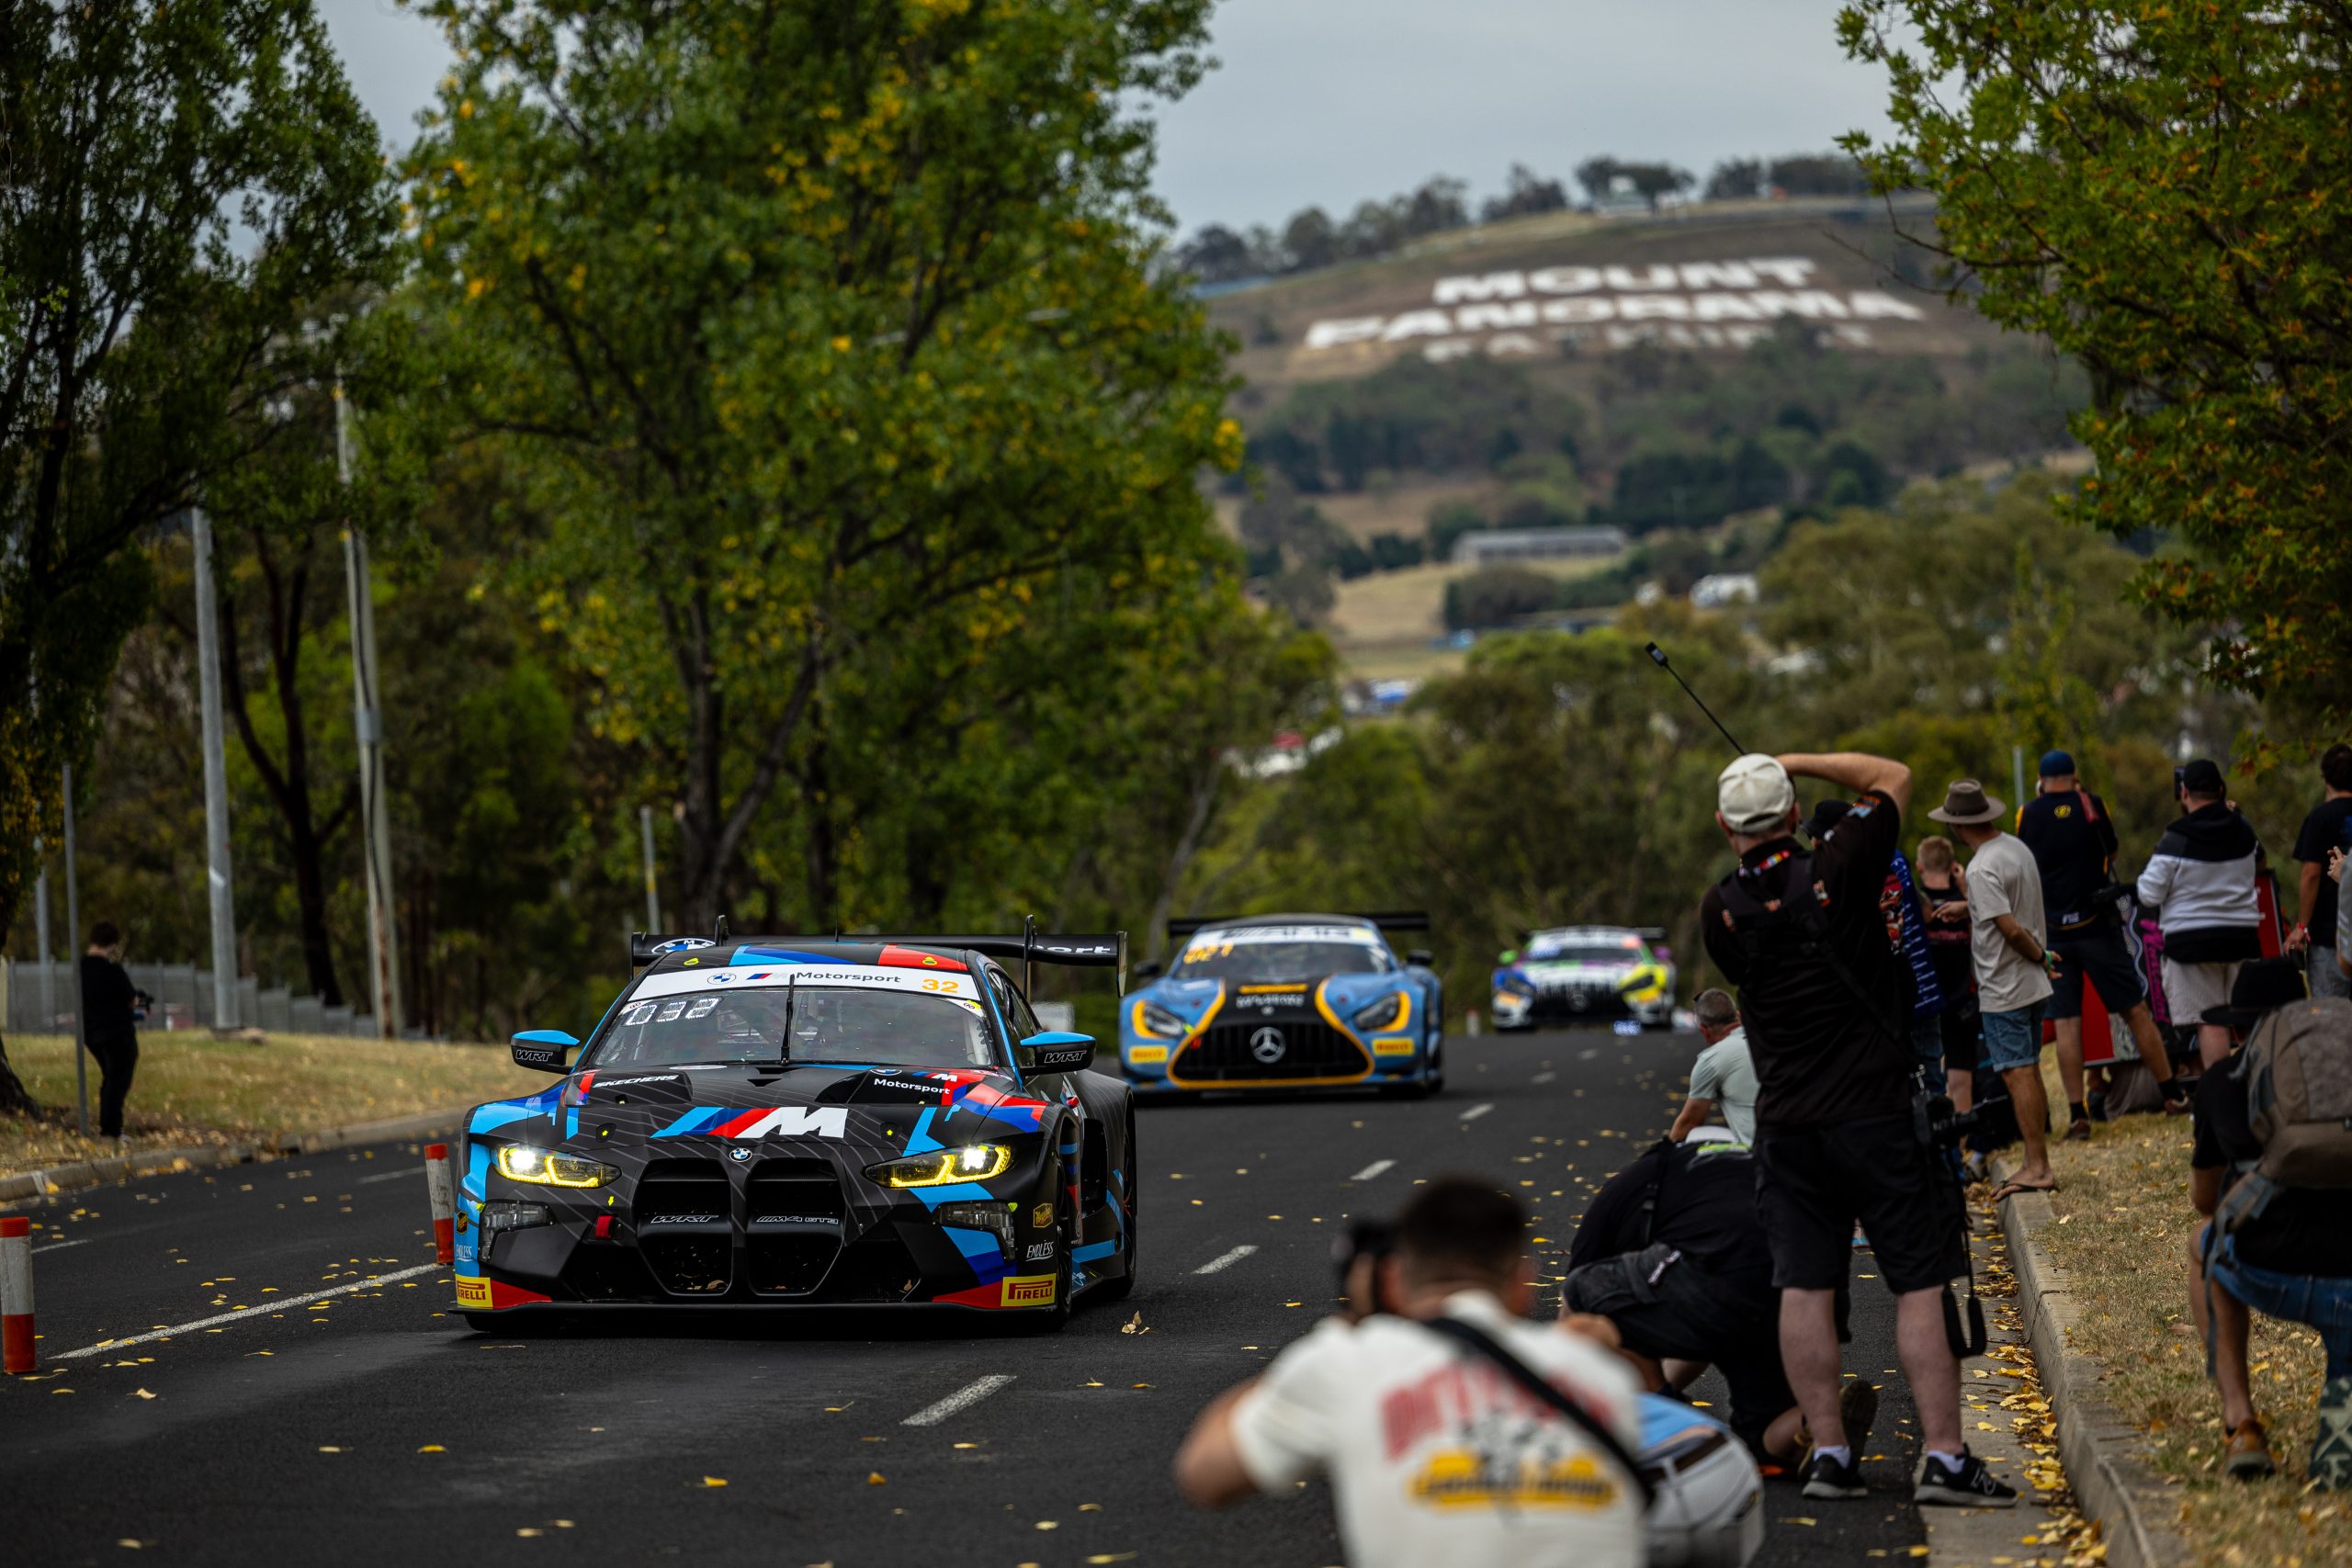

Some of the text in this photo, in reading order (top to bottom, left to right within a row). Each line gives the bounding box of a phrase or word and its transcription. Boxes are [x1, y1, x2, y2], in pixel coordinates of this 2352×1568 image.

[1432, 258, 1816, 305] MOUNT
[1305, 289, 1925, 350] PANORAMA
[796, 972, 901, 983] Motorsport
[922, 978, 959, 994] 32
[626, 997, 719, 1026] 032
[514, 1049, 553, 1062] WRT
[1044, 1050, 1087, 1064] WRT
[593, 1074, 680, 1089] SKECHERS
[874, 1077, 951, 1095] Motorsport
[650, 1214, 719, 1224] WRT
[1026, 1240, 1055, 1258] ENDLESS
[1008, 1280, 1053, 1300] PIRELLI
